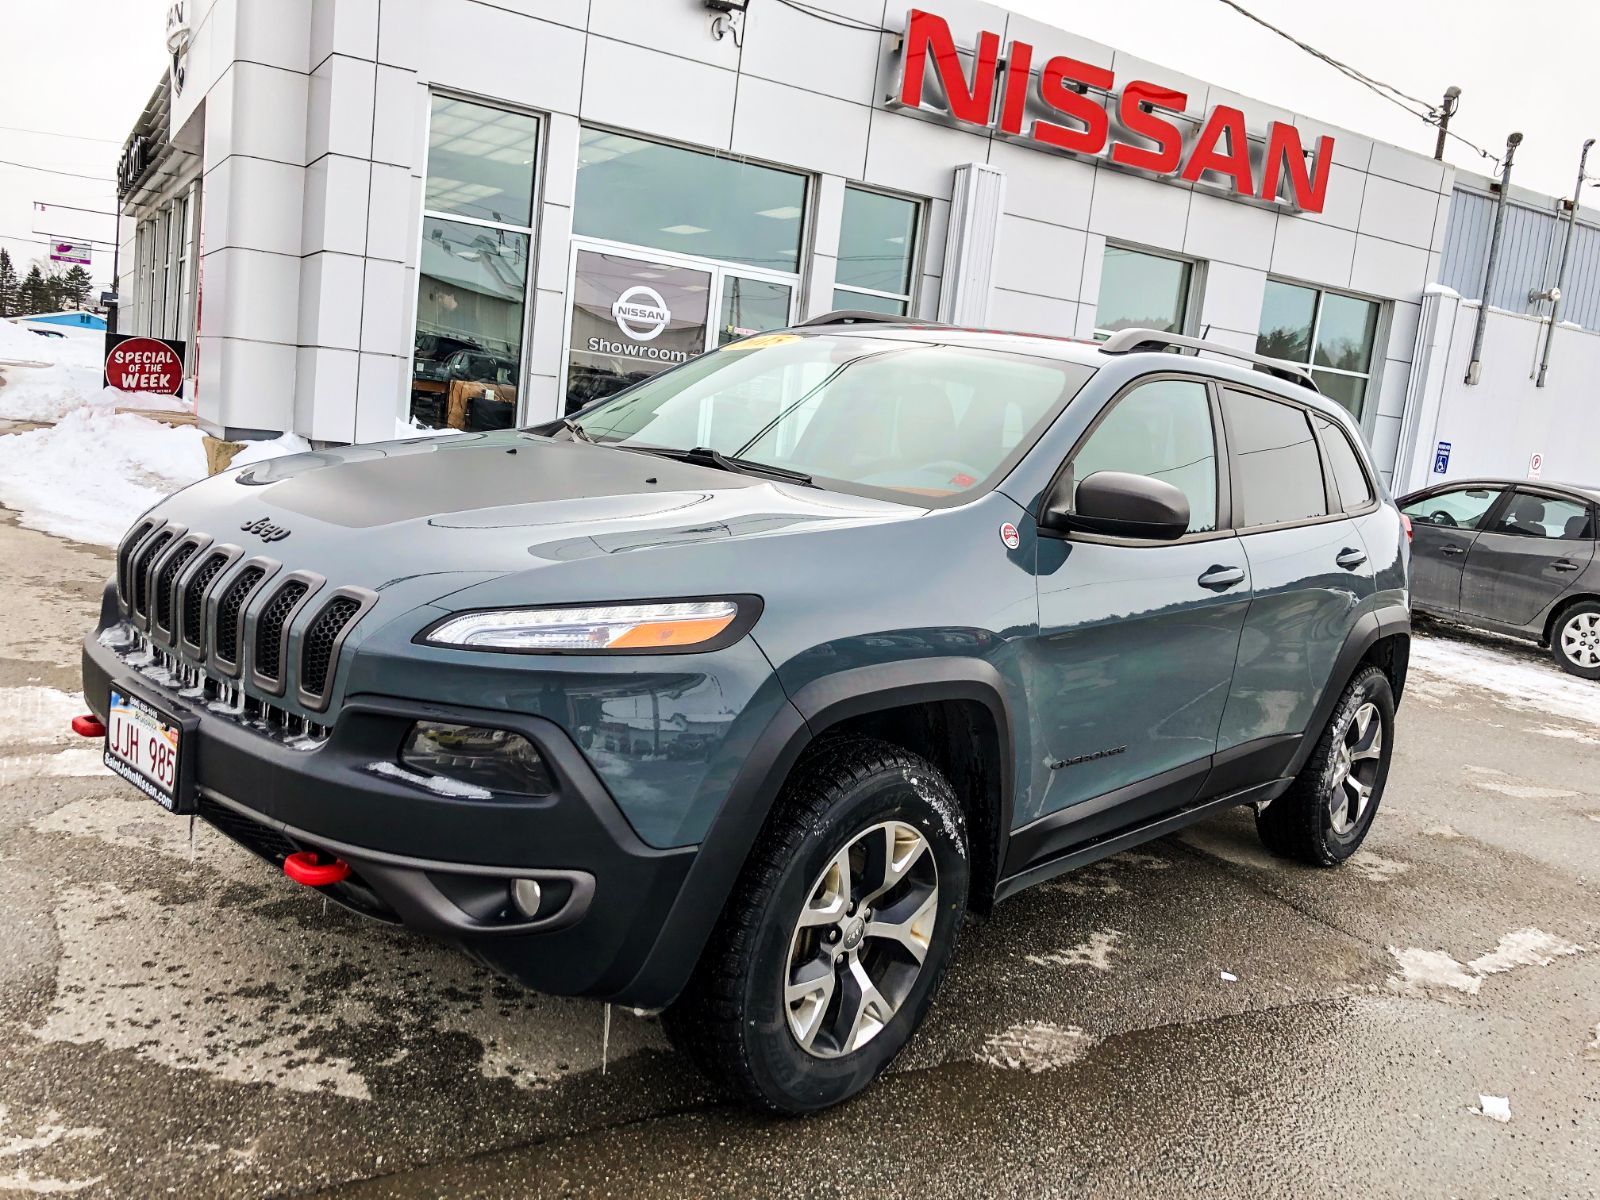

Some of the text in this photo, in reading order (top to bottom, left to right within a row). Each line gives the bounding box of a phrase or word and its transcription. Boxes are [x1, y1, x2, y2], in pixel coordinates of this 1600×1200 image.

[900, 8, 1336, 214] NISSAN
[617, 306, 666, 321] NISSAN
[114, 351, 173, 363] SPECIAL
[588, 336, 688, 362] Showroom
[121, 373, 171, 388] WEEK
[128, 364, 162, 372] OF THE
[240, 516, 291, 543] Jeep
[111, 717, 176, 787] JJH 985
[104, 751, 173, 811] SaintJohnNissan.com
